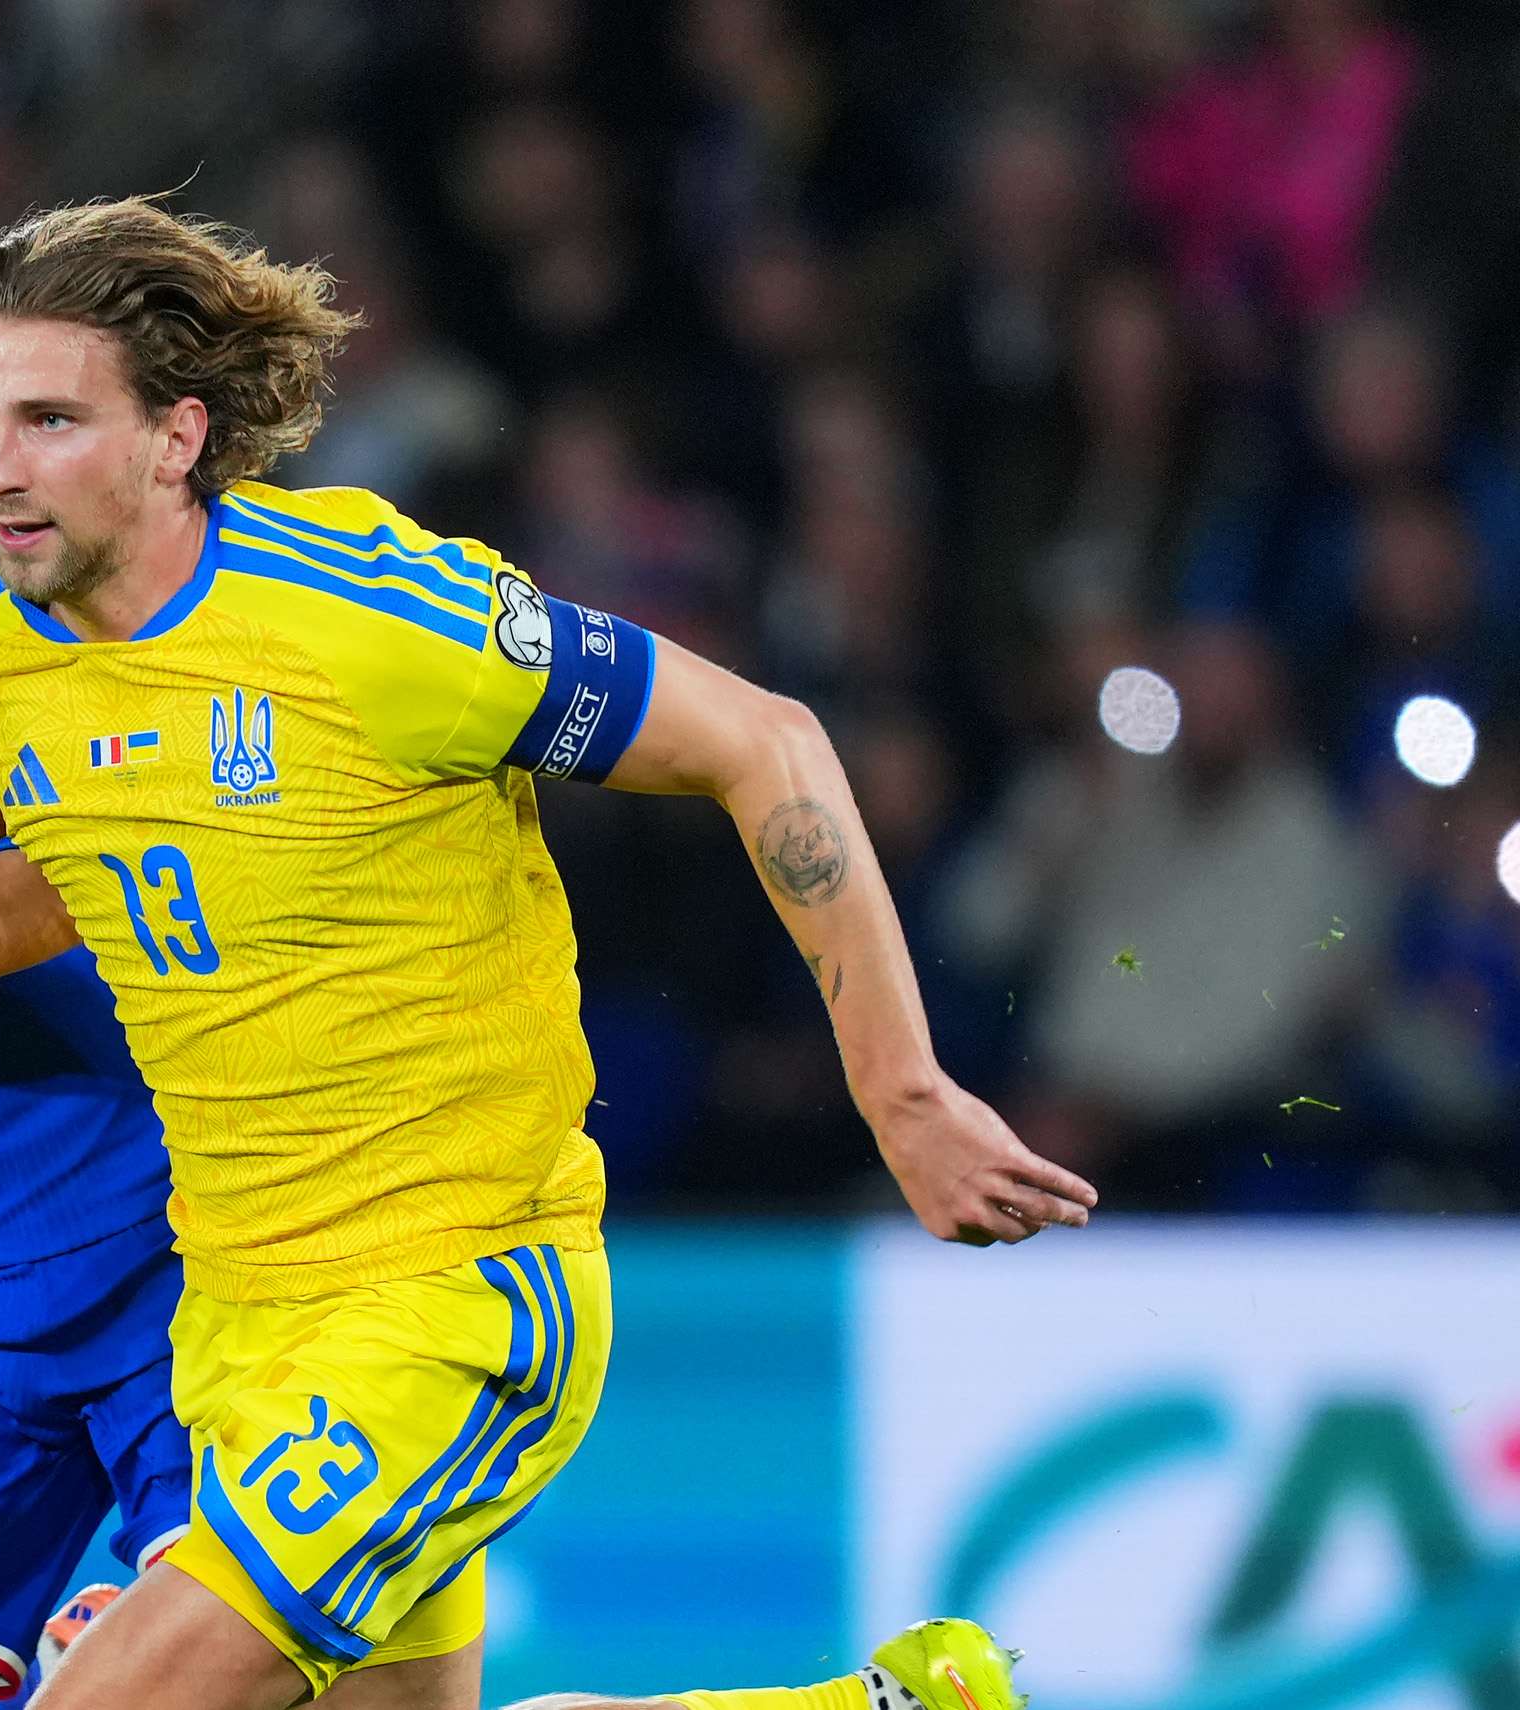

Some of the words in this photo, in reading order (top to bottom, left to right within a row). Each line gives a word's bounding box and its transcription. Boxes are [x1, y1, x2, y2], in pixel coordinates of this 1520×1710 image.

[215, 791, 281, 807] UKRAINE
[97, 845, 221, 976] 13
[239, 1394, 379, 1535] 13
